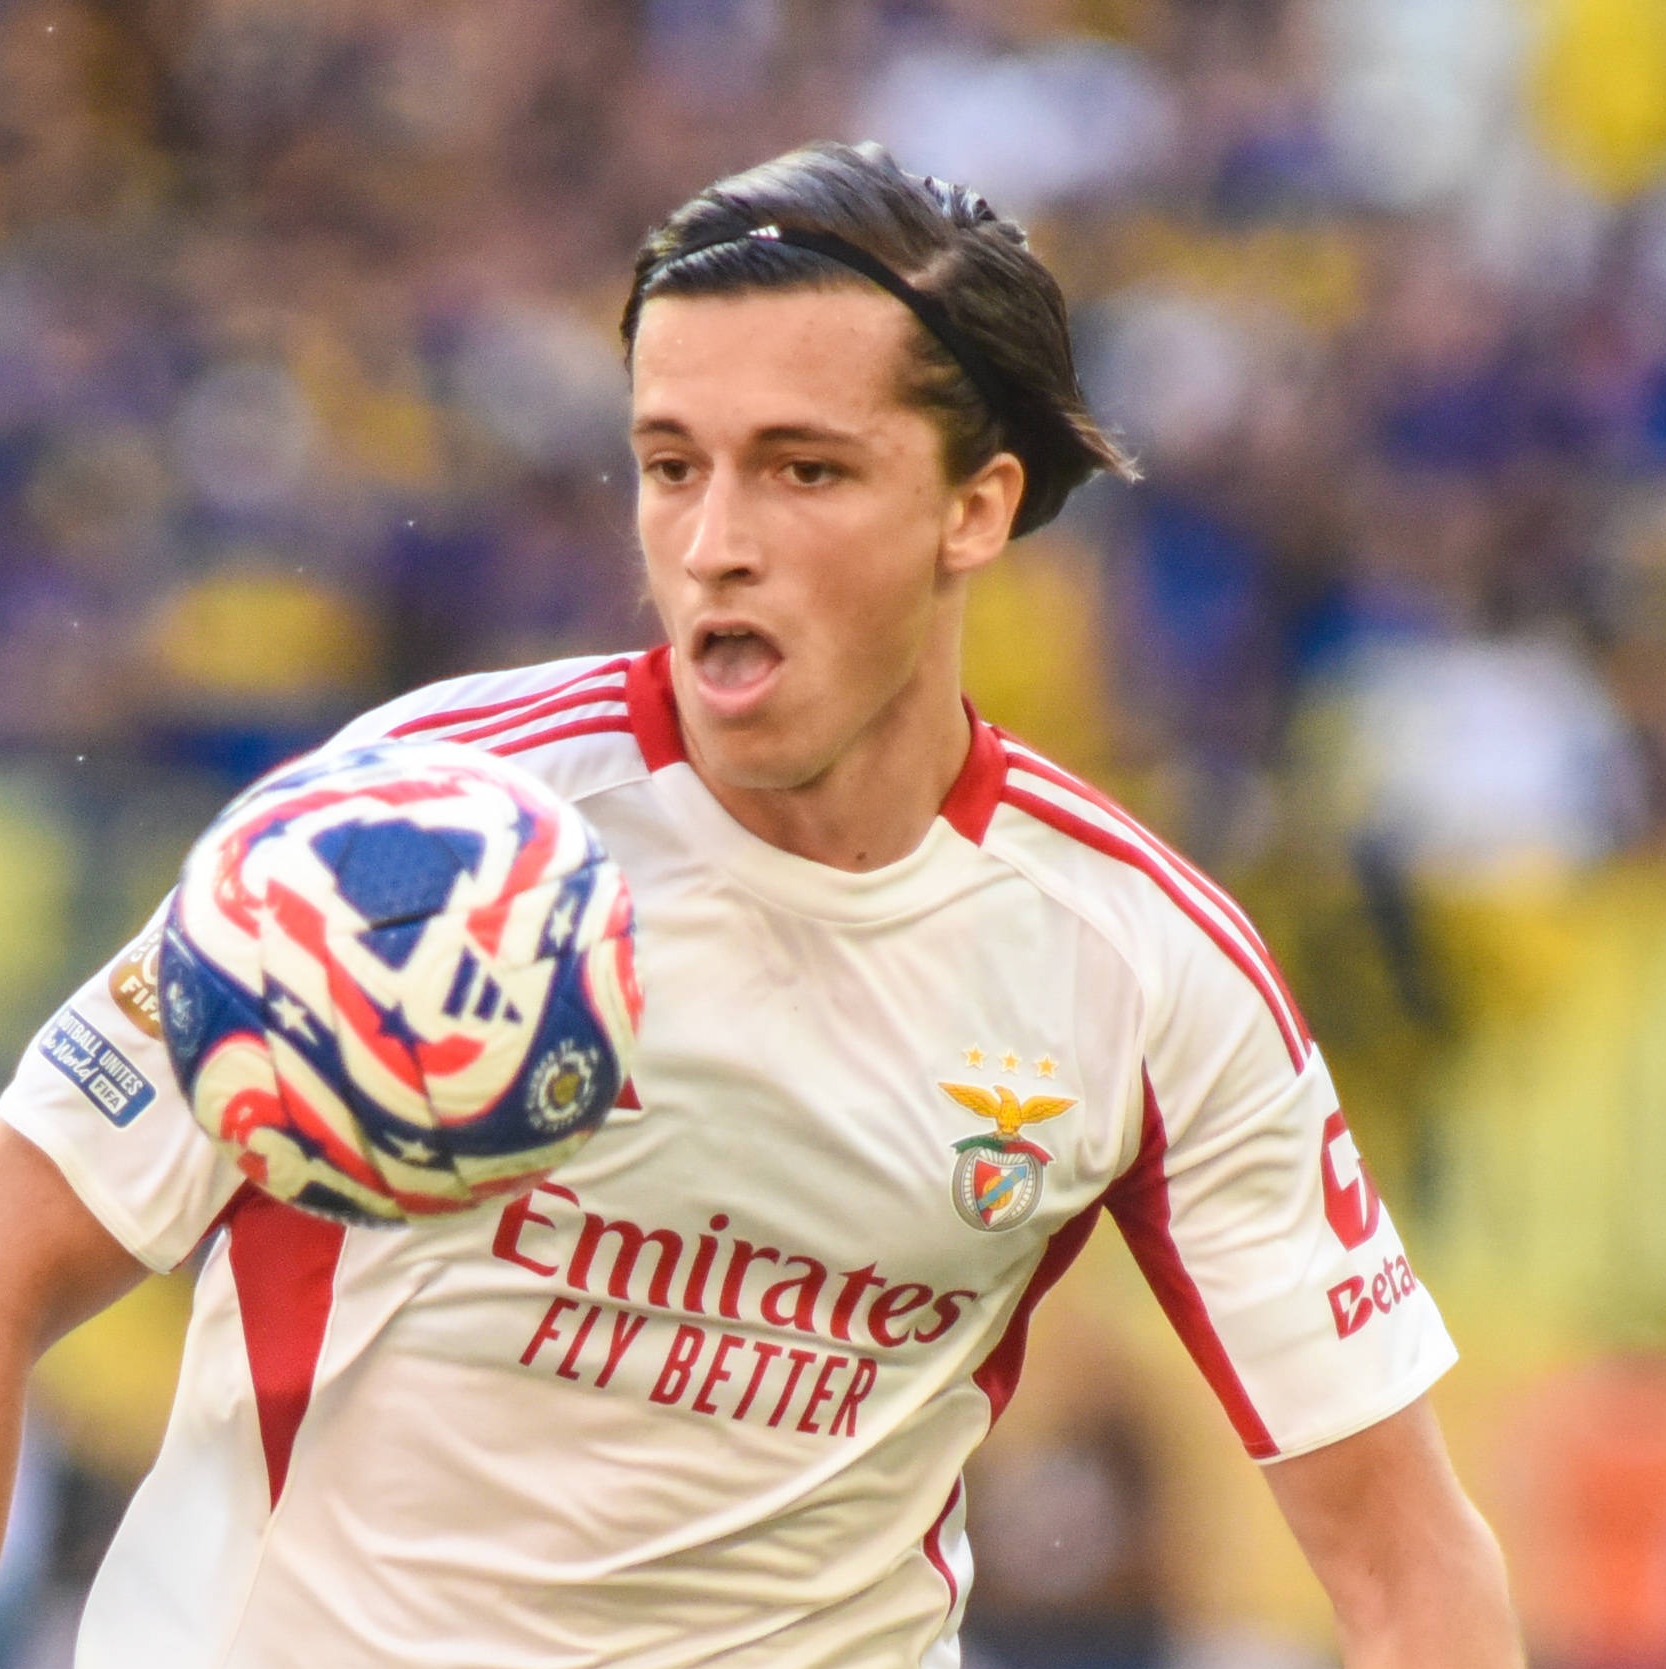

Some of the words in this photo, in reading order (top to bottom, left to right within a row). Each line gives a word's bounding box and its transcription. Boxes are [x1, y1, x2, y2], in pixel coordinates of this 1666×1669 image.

[52, 1037, 100, 1083] World
[98, 1049, 144, 1096] UNITES
[93, 1079, 122, 1111] FIFA
[491, 1181, 978, 1348] Emirates
[518, 1297, 648, 1389] FLY
[648, 1323, 878, 1438] BETTER
